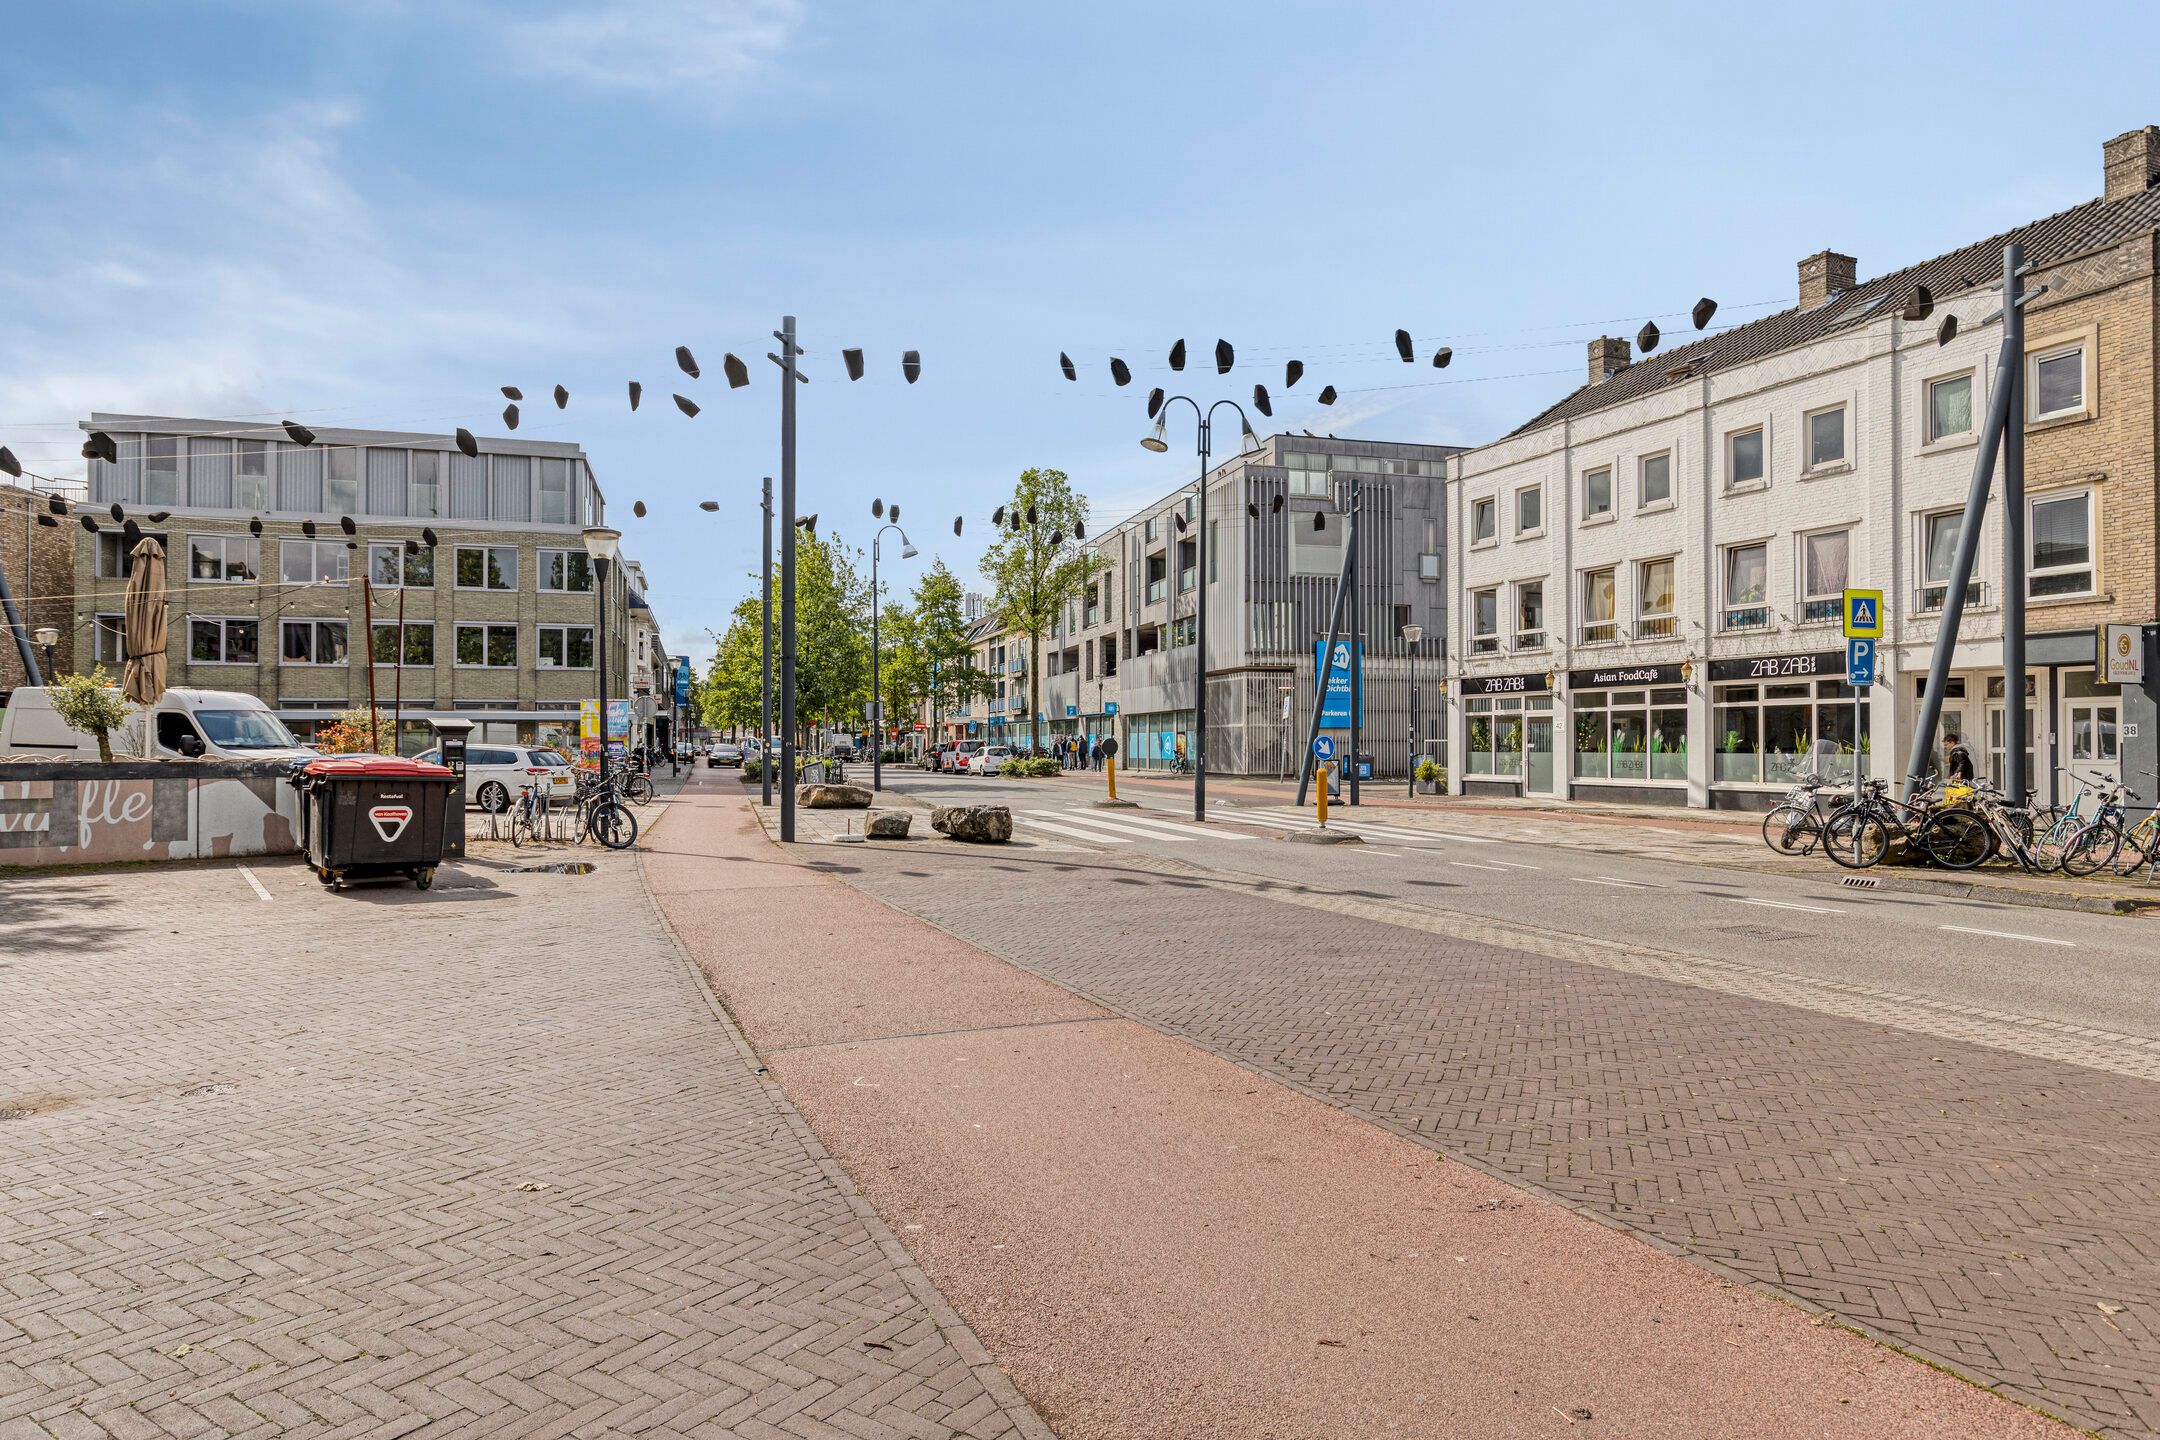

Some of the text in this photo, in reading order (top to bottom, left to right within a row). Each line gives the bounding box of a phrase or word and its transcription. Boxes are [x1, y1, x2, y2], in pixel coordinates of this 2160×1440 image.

[1854, 641, 1869, 665] P
[1750, 659, 1779, 676] ZAB
[1781, 656, 1810, 674] ZAB
[2110, 658, 2139, 671] GoudNL
[1593, 673, 1617, 682] Asian
[1485, 678, 1503, 692] ZAB
[2123, 726, 2136, 735] 38
